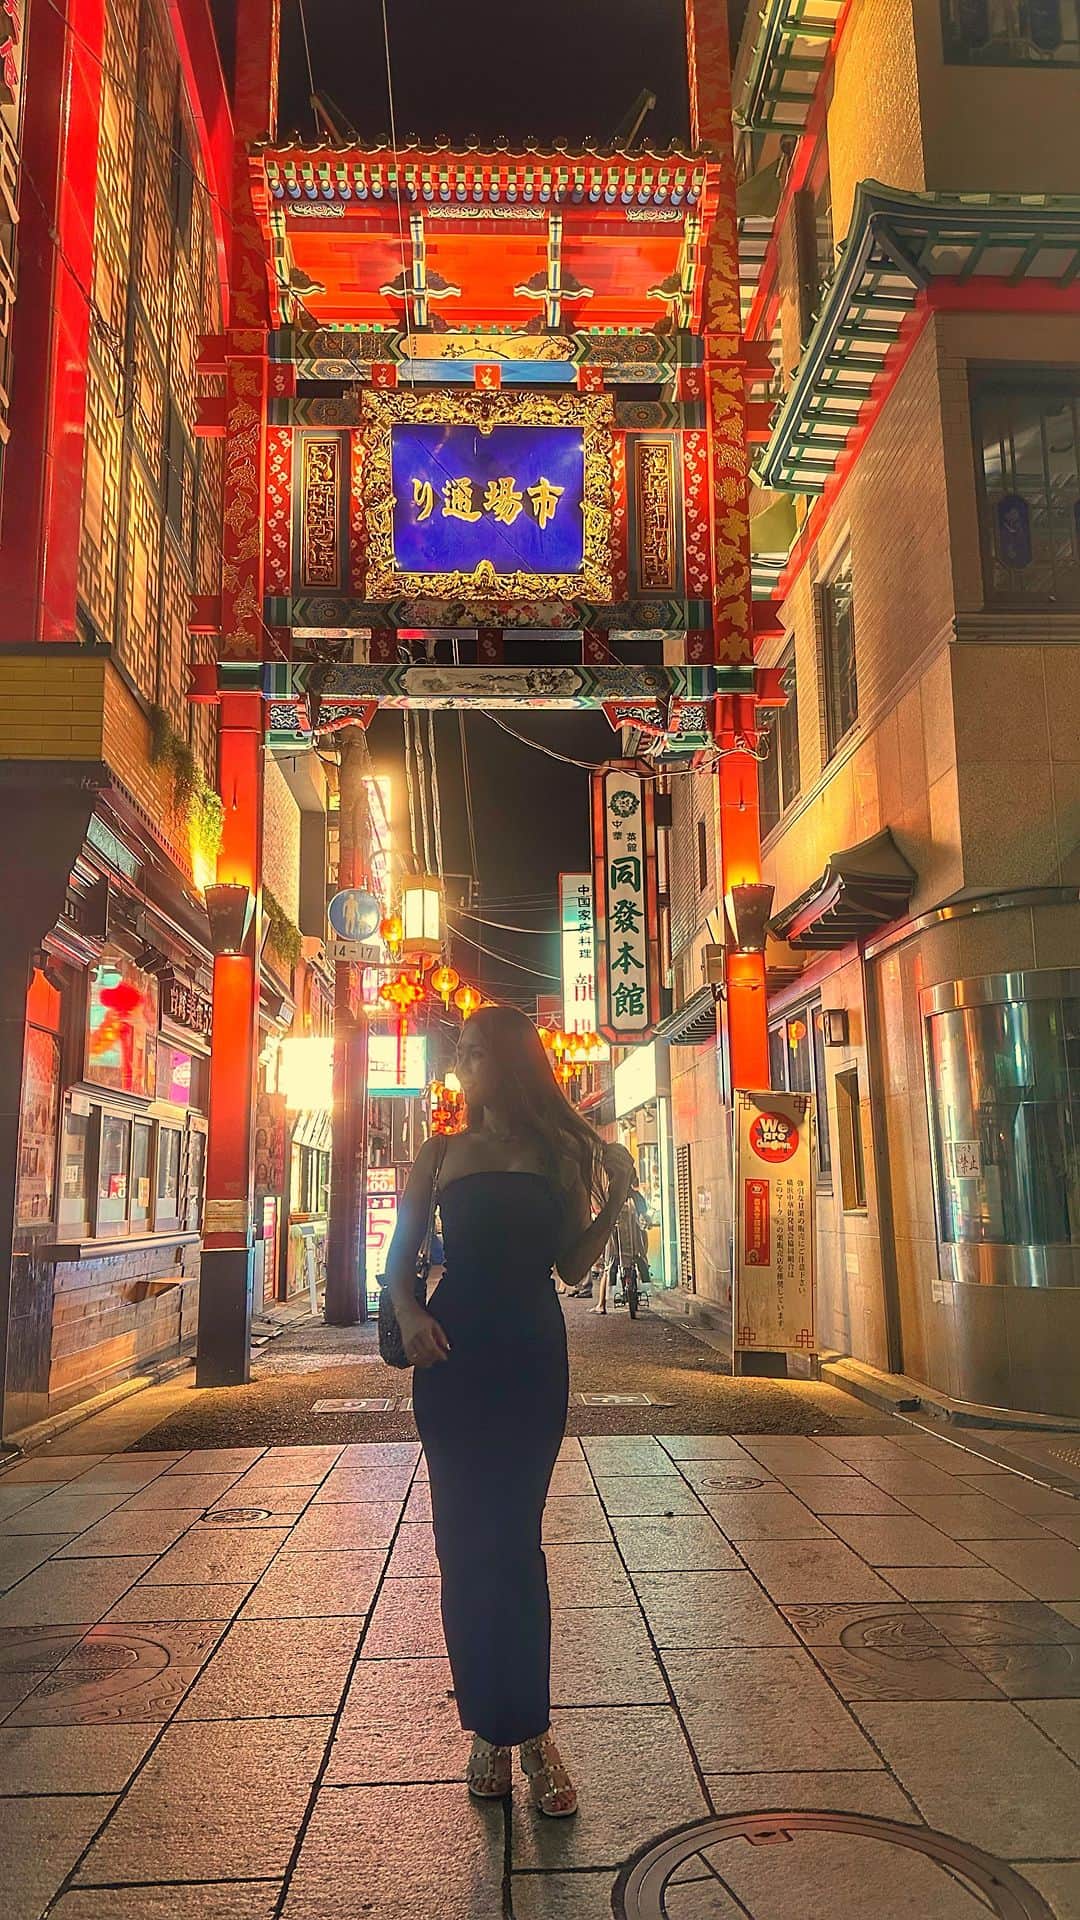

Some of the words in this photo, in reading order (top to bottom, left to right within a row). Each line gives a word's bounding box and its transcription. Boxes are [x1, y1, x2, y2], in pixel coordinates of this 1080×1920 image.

[410, 476, 565, 529] 市場通り
[609, 856, 645, 1018] 同發本館
[333, 944, 373, 960] 14-17
[759, 1118, 789, 1133] We
[763, 1132, 786, 1141] are
